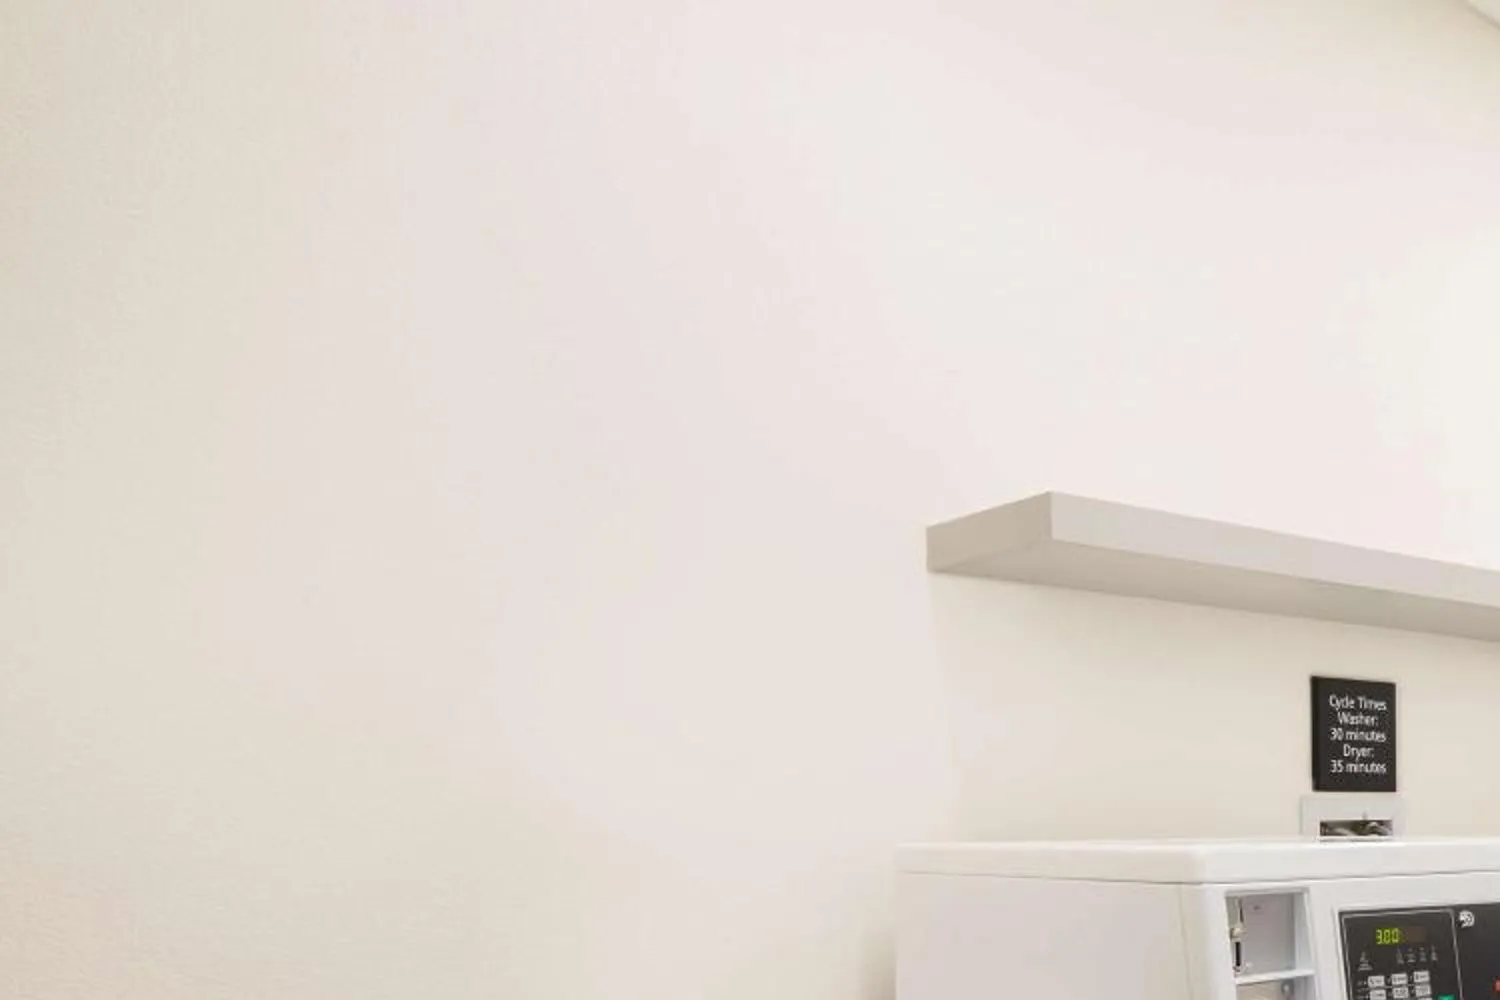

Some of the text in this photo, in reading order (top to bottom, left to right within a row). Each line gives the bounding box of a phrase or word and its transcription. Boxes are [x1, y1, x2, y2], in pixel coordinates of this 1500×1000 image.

[1329, 694, 1387, 711] Cycle Times
[1337, 711, 1379, 726] Washer:
[1330, 727, 1387, 742] 30 minutes
[1343, 743, 1375, 762] Dryer:
[1330, 759, 1387, 774] 35 minutes
